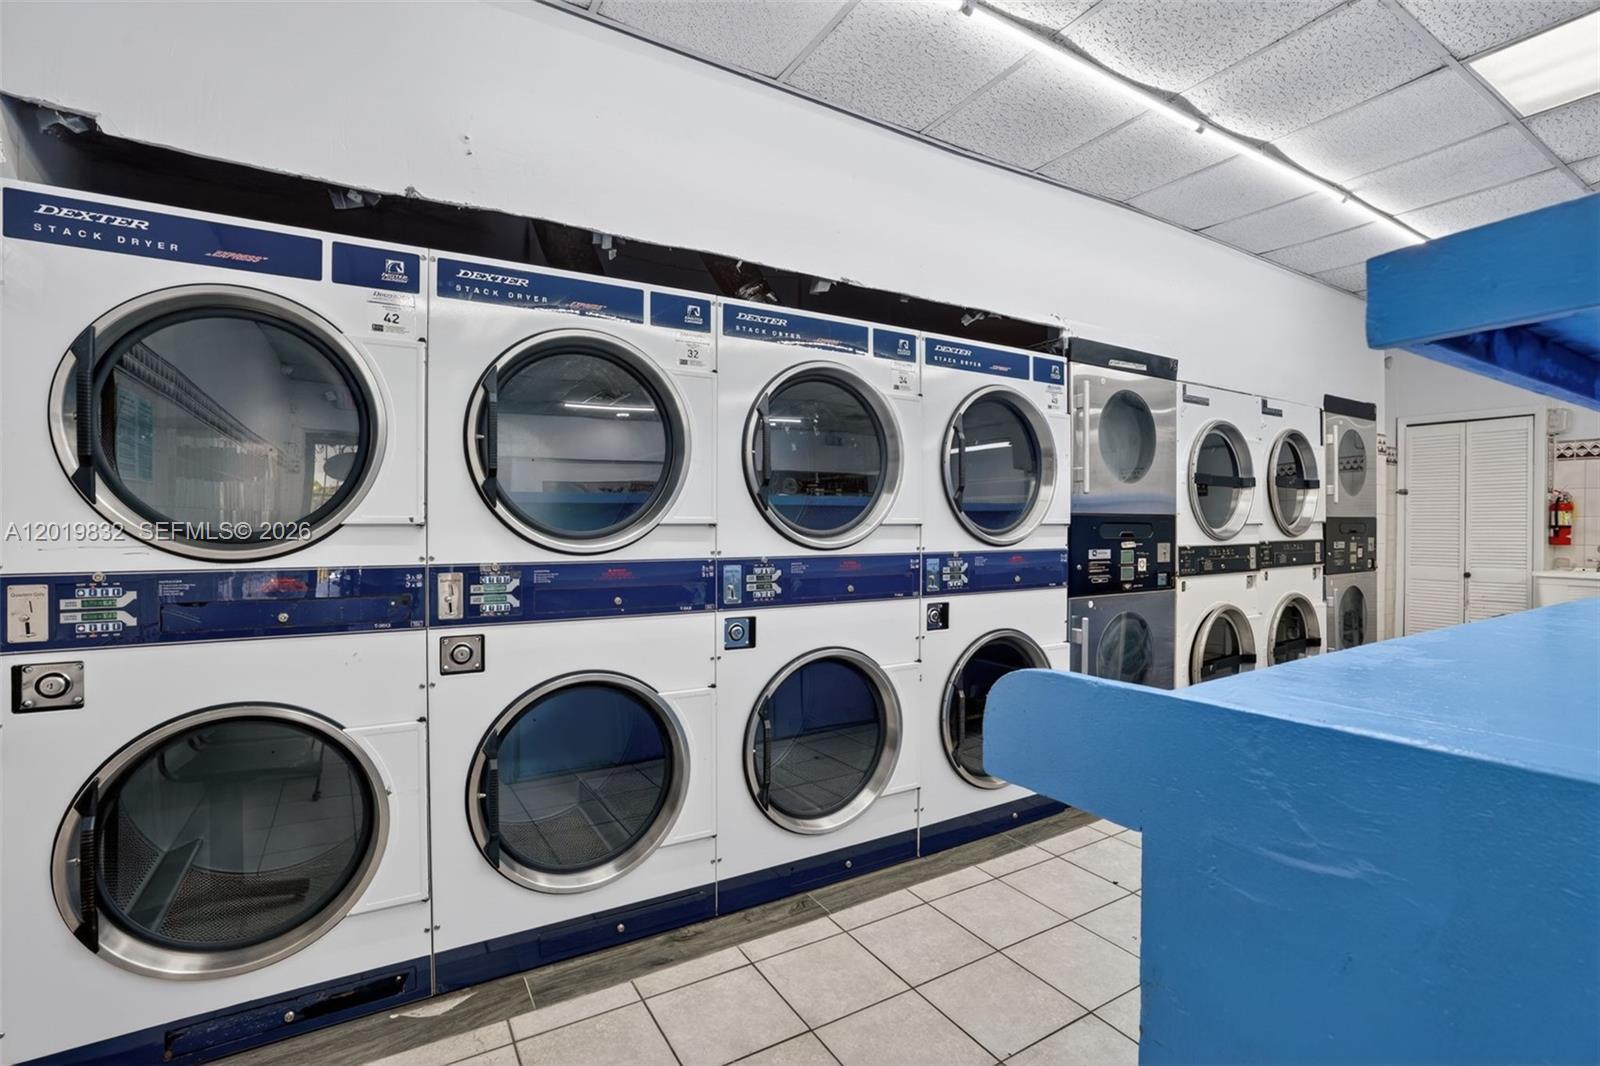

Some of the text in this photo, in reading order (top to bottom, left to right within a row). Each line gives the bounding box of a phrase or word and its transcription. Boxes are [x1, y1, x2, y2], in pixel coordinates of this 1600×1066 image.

[34, 203, 150, 231] DEXTER
[33, 222, 179, 252] STACK DRYER
[455, 268, 530, 288] DEXTER
[455, 284, 549, 303] STACK DRYER
[383, 312, 401, 325] 42
[735, 311, 789, 327] DEXTER
[735, 324, 801, 340] STACK DRYER
[934, 344, 973, 357] DEXTER
